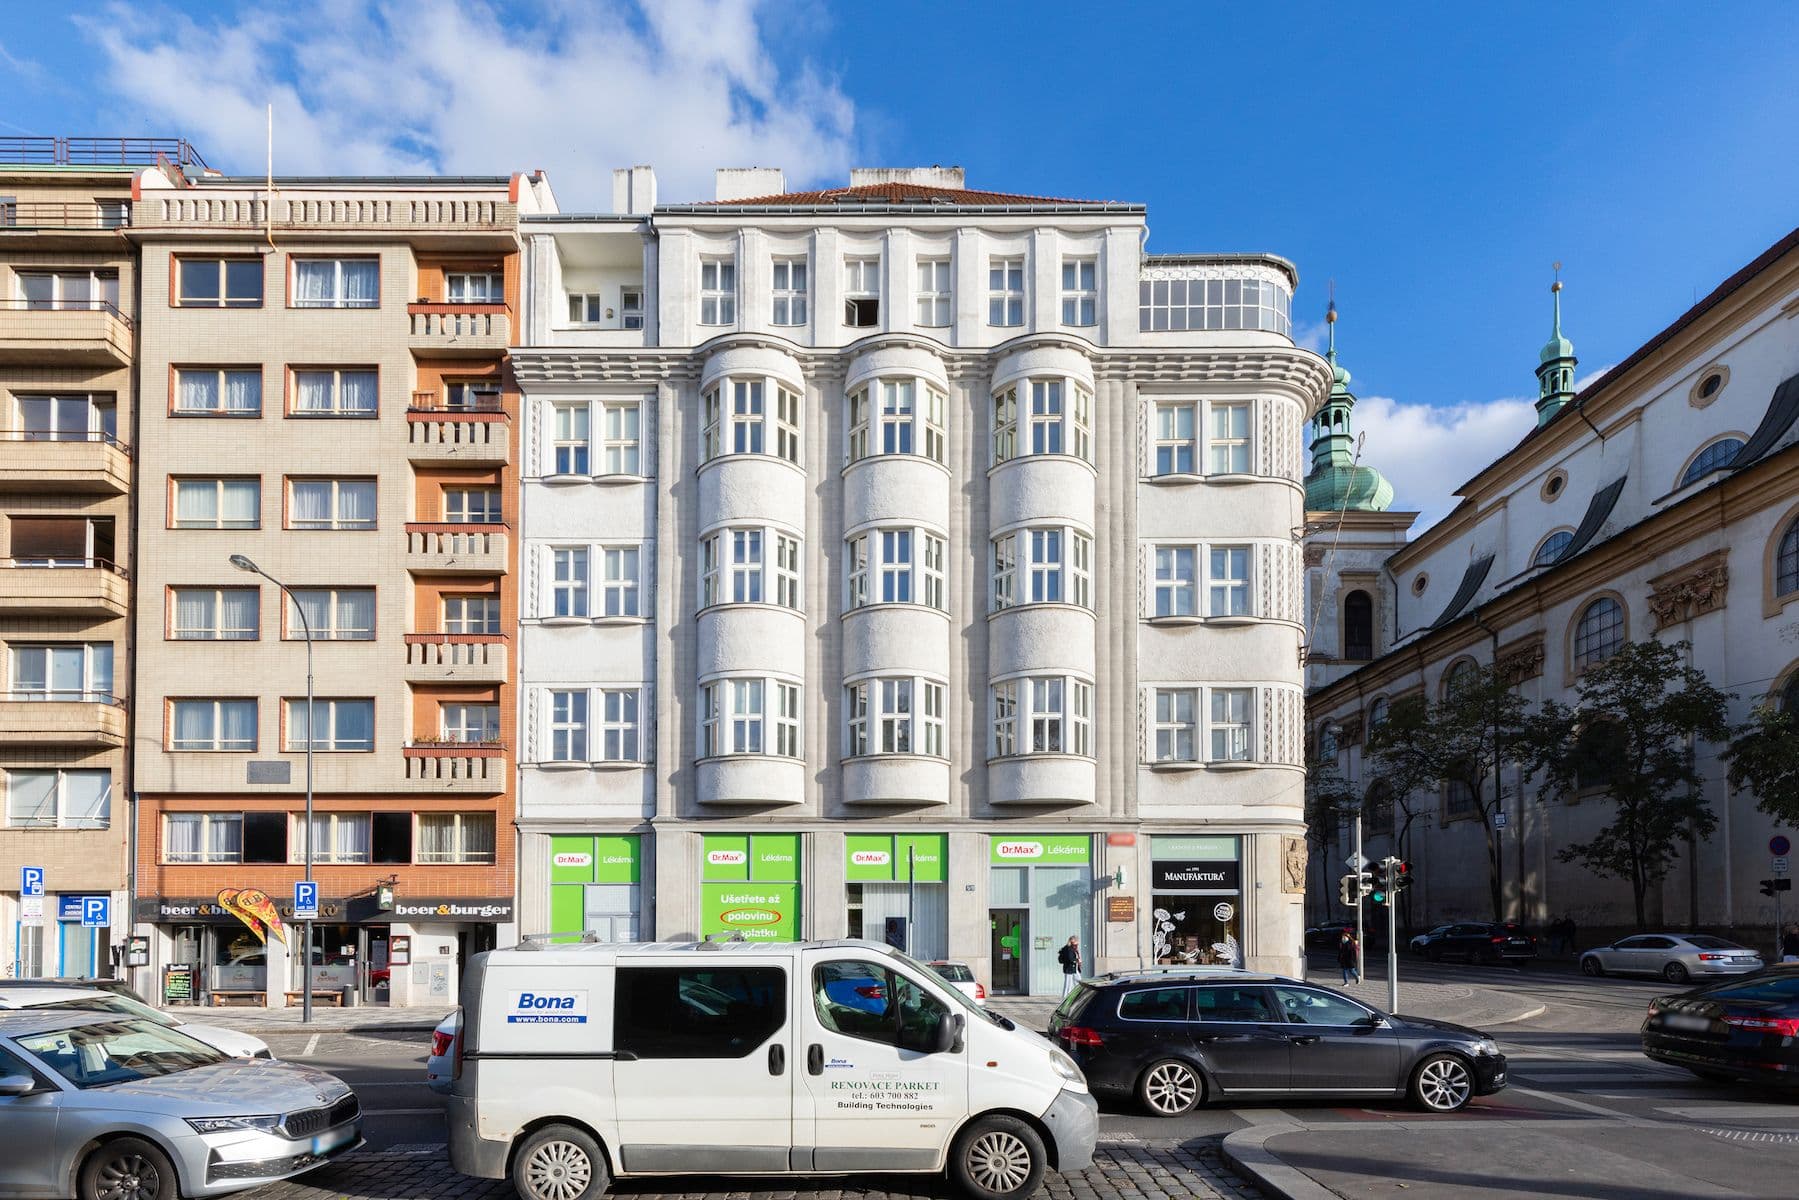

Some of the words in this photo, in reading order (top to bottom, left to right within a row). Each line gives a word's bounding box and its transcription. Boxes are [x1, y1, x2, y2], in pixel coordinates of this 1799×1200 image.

[1002, 845, 1034, 854] Dr.Max
[1047, 845, 1086, 855] Lékárna
[558, 856, 585, 864] Dr.Max
[602, 856, 634, 864] Lékárna
[761, 853, 793, 862] Lékárna
[26, 869, 40, 888] P
[1164, 871, 1225, 881] MANUFAKTURA
[299, 885, 313, 903] P
[720, 893, 766, 904] Ušetřete
[768, 893, 781, 904] až
[87, 900, 104, 919] P
[395, 904, 511, 917] beer&burger
[727, 911, 773, 923] polovinu
[518, 992, 576, 1009] Bona
[515, 1015, 579, 1023] www.bona.com
[831, 1081, 892, 1090] RENOVACE
[895, 1081, 940, 1090] PARKET
[852, 1092, 867, 1100] tel.:
[870, 1092, 885, 1100] 603
[887, 1092, 902, 1100] 700
[904, 1092, 919, 1100] 882
[837, 1101, 873, 1111] Building
[876, 1102, 934, 1112] Technologies
